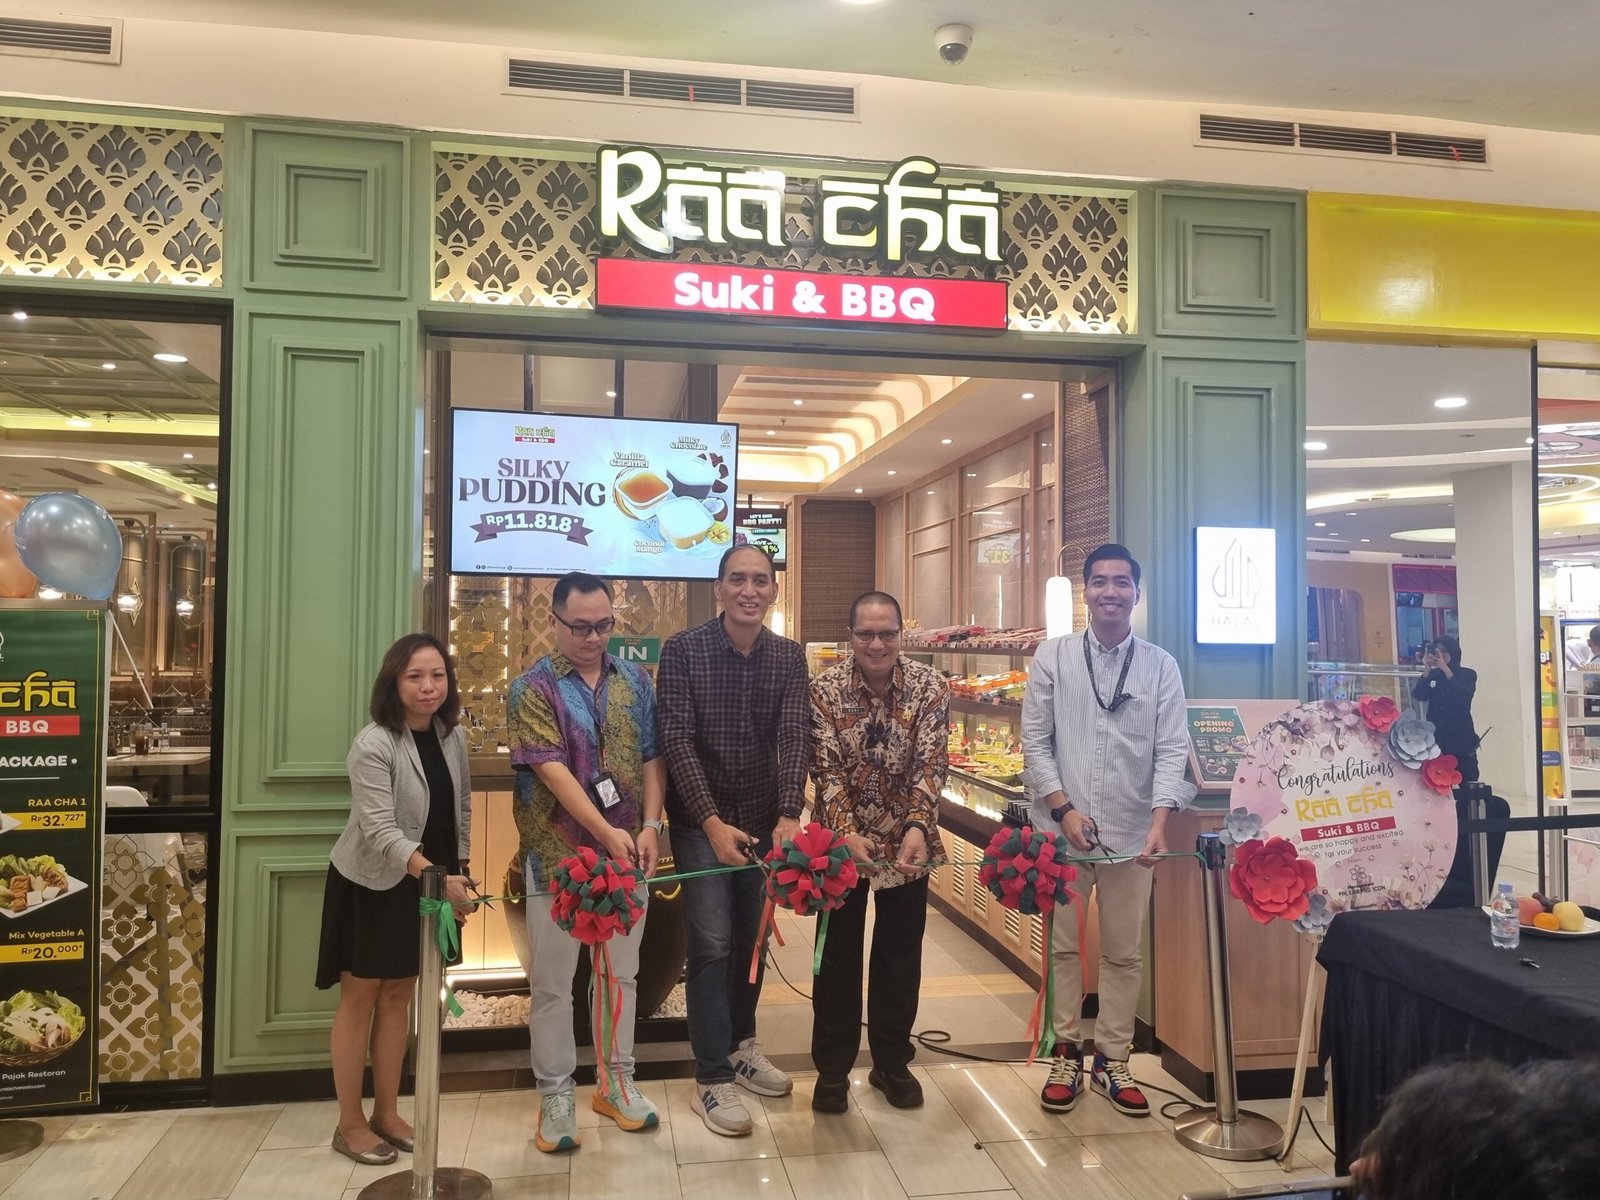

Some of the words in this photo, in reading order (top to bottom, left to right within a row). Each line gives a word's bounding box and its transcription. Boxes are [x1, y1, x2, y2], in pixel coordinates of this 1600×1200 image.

[674, 272, 774, 311] Suki
[792, 280, 827, 314] &
[842, 283, 935, 322] BBQ
[678, 437, 700, 446] Milky
[610, 459, 649, 468] Caramel
[614, 452, 645, 461] Vanilla
[498, 457, 571, 480] SILKY
[458, 477, 606, 507] PUDDING
[633, 540, 665, 548] Coconut
[636, 546, 664, 554] Mango
[619, 646, 647, 660] IN
[6, 720, 49, 734] BBQ
[1277, 756, 1395, 796] Congratulations
[28, 799, 52, 807] RAA
[54, 798, 78, 806] CHA
[80, 798, 87, 806] 1
[1317, 827, 1341, 838] Suki
[1345, 825, 1354, 833] &
[1356, 821, 1380, 832] BBQ
[1298, 845, 1309, 853] we
[1311, 844, 1323, 852] are
[1334, 838, 1358, 847] happy
[1360, 834, 1375, 842] and
[1376, 829, 1404, 839] excited
[1324, 850, 1335, 858] for
[1337, 847, 1352, 857] your
[1353, 844, 1382, 854] success
[28, 929, 75, 940] Vegetable
[77, 928, 85, 936] A
[2, 1072, 26, 1081] Pajak
[28, 1070, 66, 1078] Restoran
